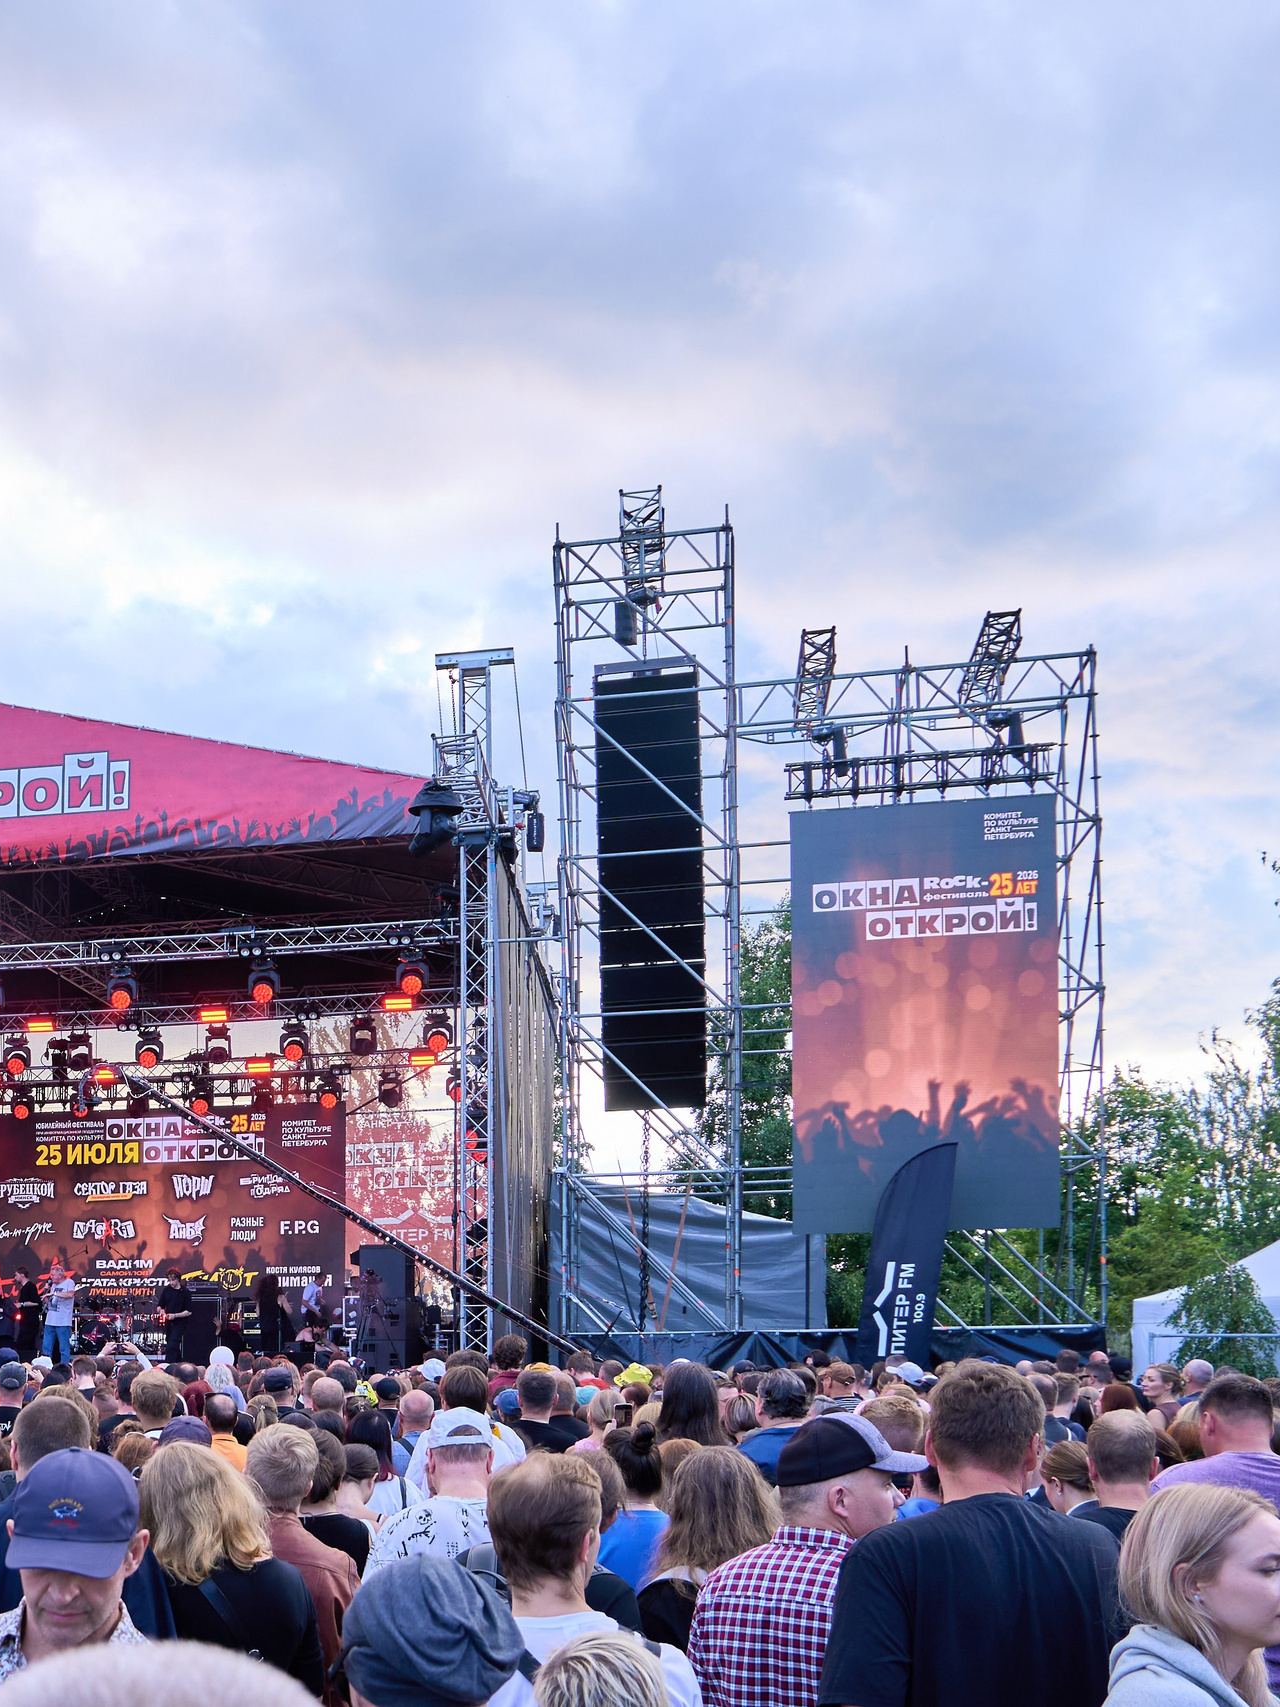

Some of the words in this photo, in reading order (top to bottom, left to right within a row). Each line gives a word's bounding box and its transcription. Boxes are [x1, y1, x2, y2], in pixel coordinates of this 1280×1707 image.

[984, 811, 1022, 820] КОМИТЕТ
[998, 817, 1039, 826] КУЛЬТУРЕ
[984, 831, 1035, 841] ПЕТЕРБУРГА
[1017, 870, 1039, 880] 2026
[988, 872, 1014, 897] 25
[1015, 880, 1039, 895] ЛЕТ
[814, 884, 918, 910] ОКНА
[923, 890, 989, 902] фестиваль
[867, 898, 1036, 938] ОТКРОЙ!
[35, 1121, 72, 1130] ЮБИЛЕЙНЫЙ
[72, 1120, 105, 1129] ФЕСТИВАЛЬ
[231, 1114, 248, 1132] 25
[249, 1121, 266, 1132] ЛЕТ
[281, 1119, 317, 1127] КОМИТЕТ
[107, 1121, 181, 1139] ОКНА
[294, 1125, 332, 1134] КУЛЬТУРЕ
[281, 1138, 328, 1148] ПЕТЕРБУРГА
[35, 1144, 62, 1166] 25
[67, 1142, 139, 1165] ИЮЛЯ
[73, 1181, 116, 1196] СЕКТОР
[119, 1180, 148, 1195] ГАЗА
[230, 1216, 265, 1228] РАЗНЫЕ
[279, 1220, 320, 1236] F.P.G
[230, 1230, 257, 1242] ЛЮДИ
[266, 1266, 288, 1274] КОСТЯ
[289, 1266, 321, 1274] КУЛЯСОВ
[897, 1263, 916, 1289] FM
[88, 1288, 128, 1296] ЛУЧШИЕ
[913, 1293, 926, 1323] 100.9
[890, 1294, 911, 1355] ПИТЕР
